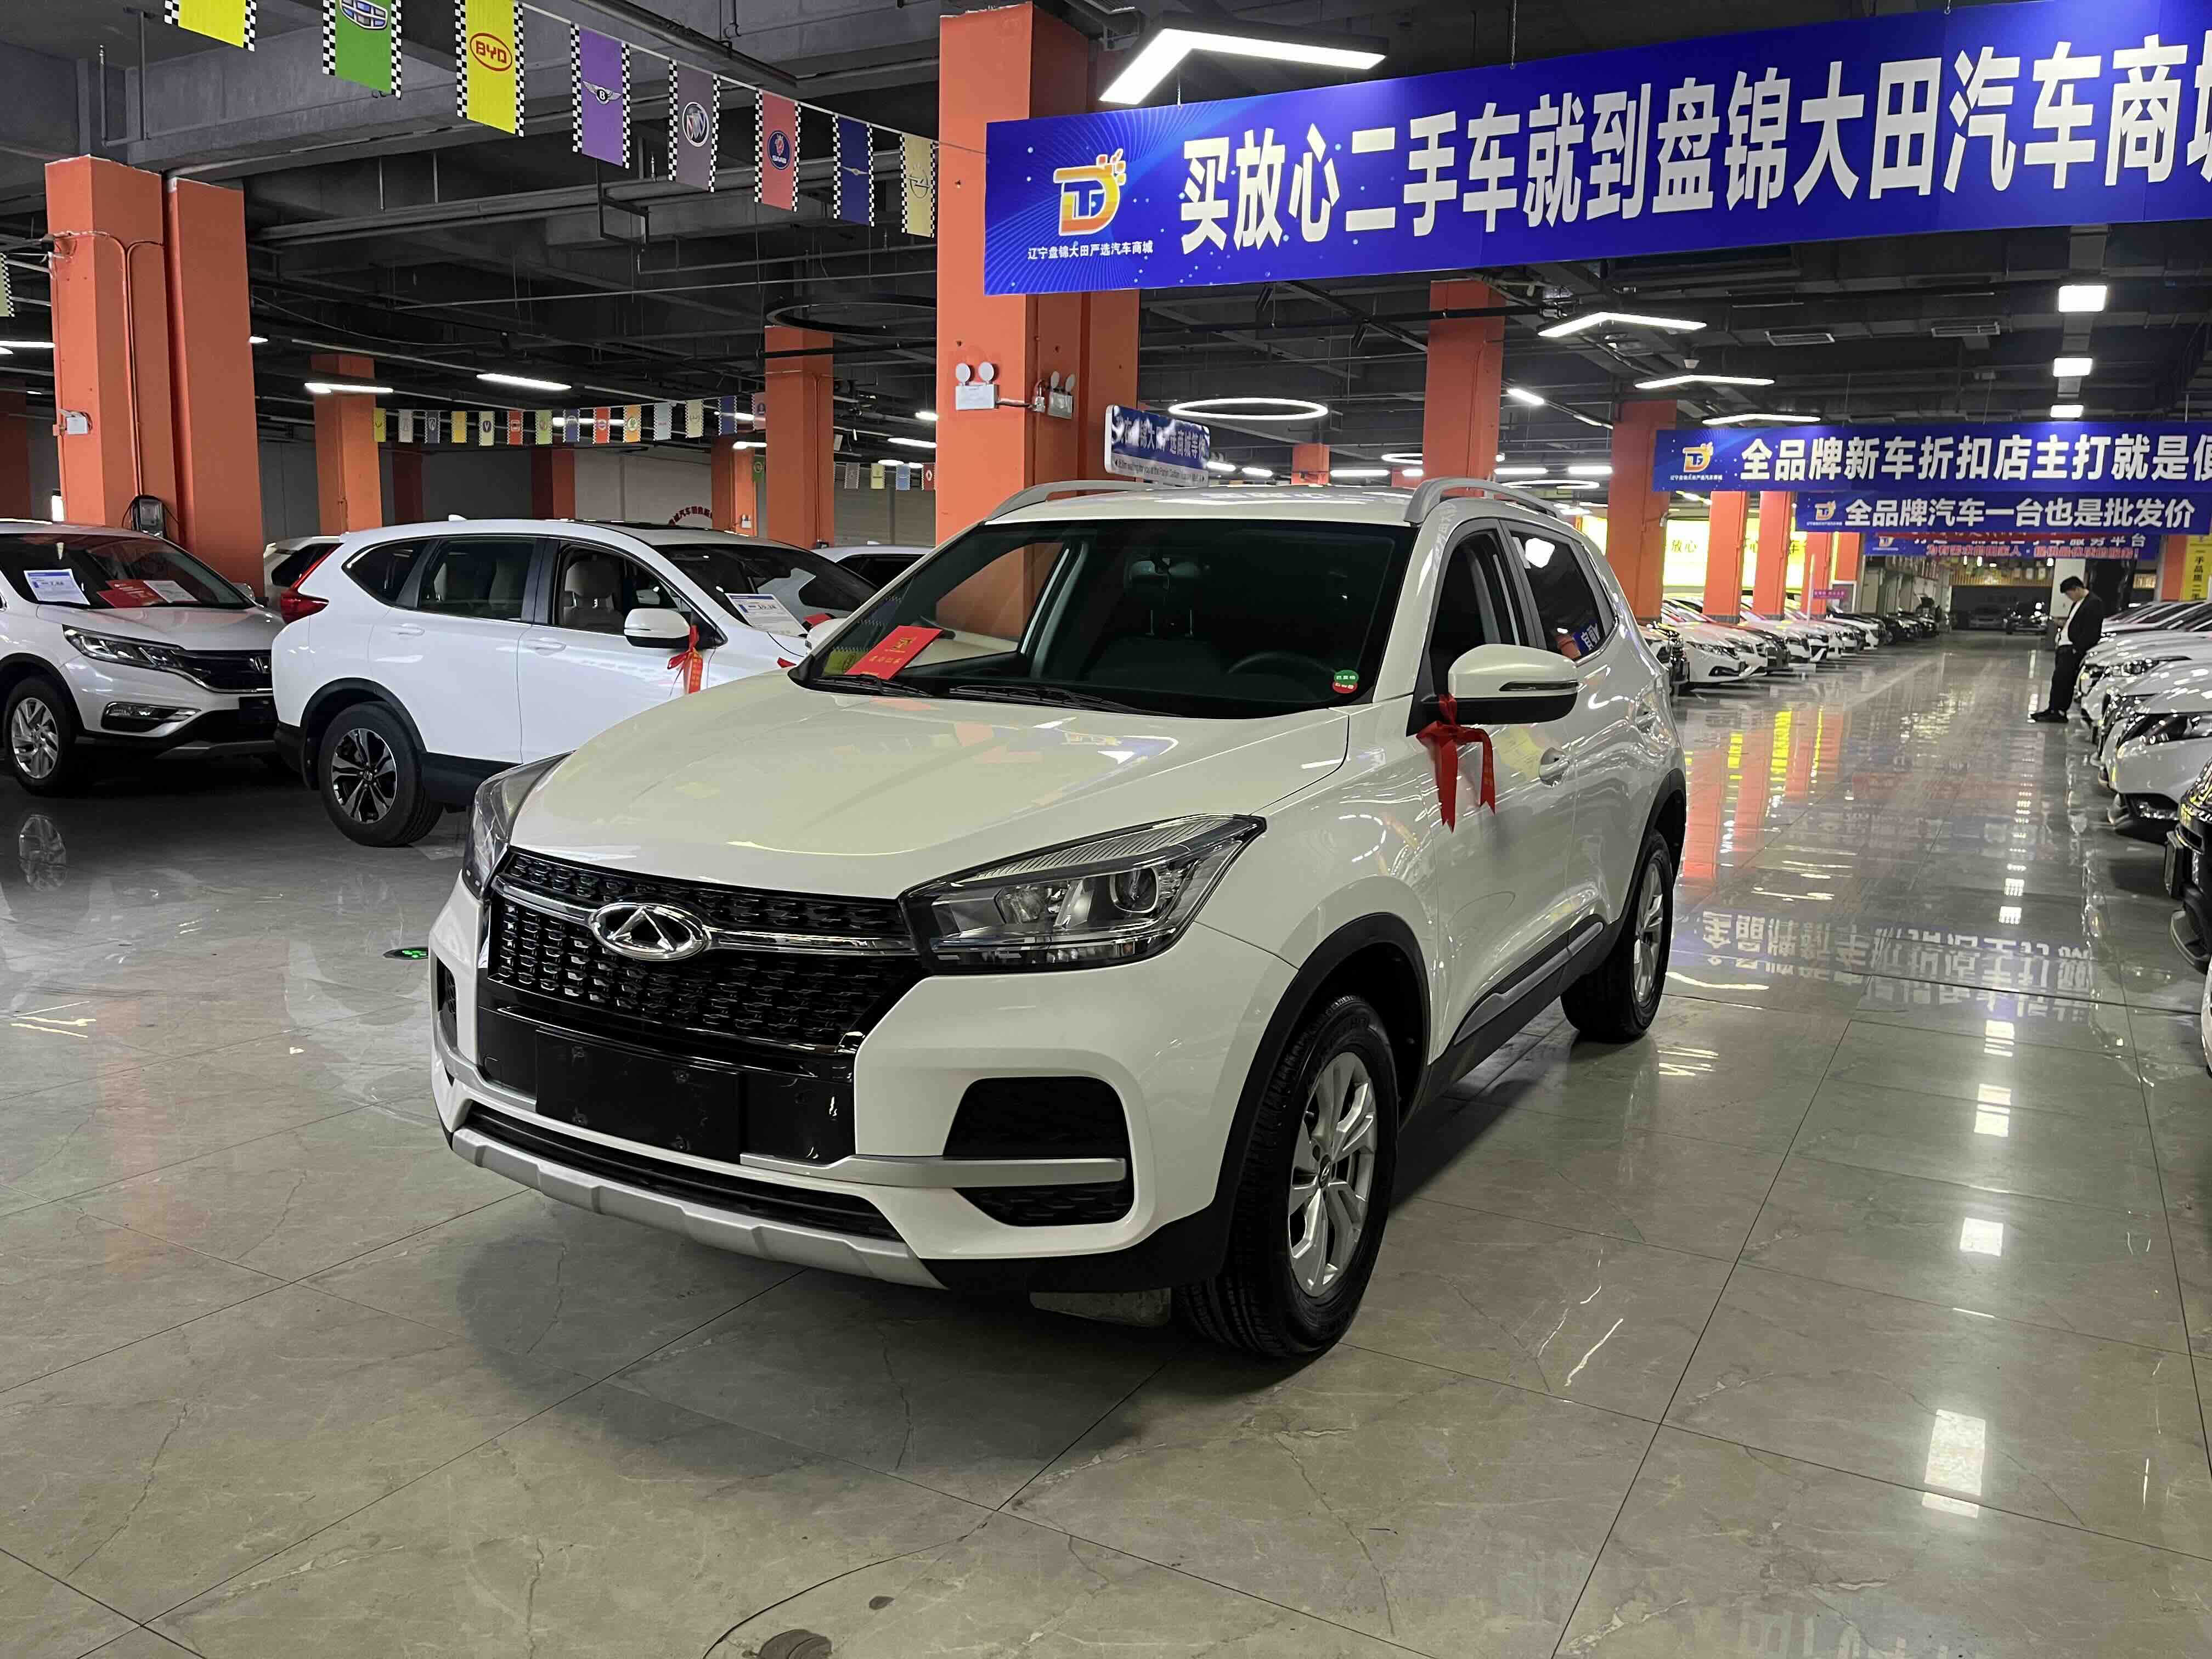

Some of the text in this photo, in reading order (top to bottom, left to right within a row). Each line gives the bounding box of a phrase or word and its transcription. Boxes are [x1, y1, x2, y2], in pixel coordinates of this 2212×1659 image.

[475, 40, 508, 63] BYD
[1027, 240, 1154, 260] 辽宁盘锦大田严选汽车商城
[1845, 498, 2194, 528] 全品牌汽车一台也是批发价
